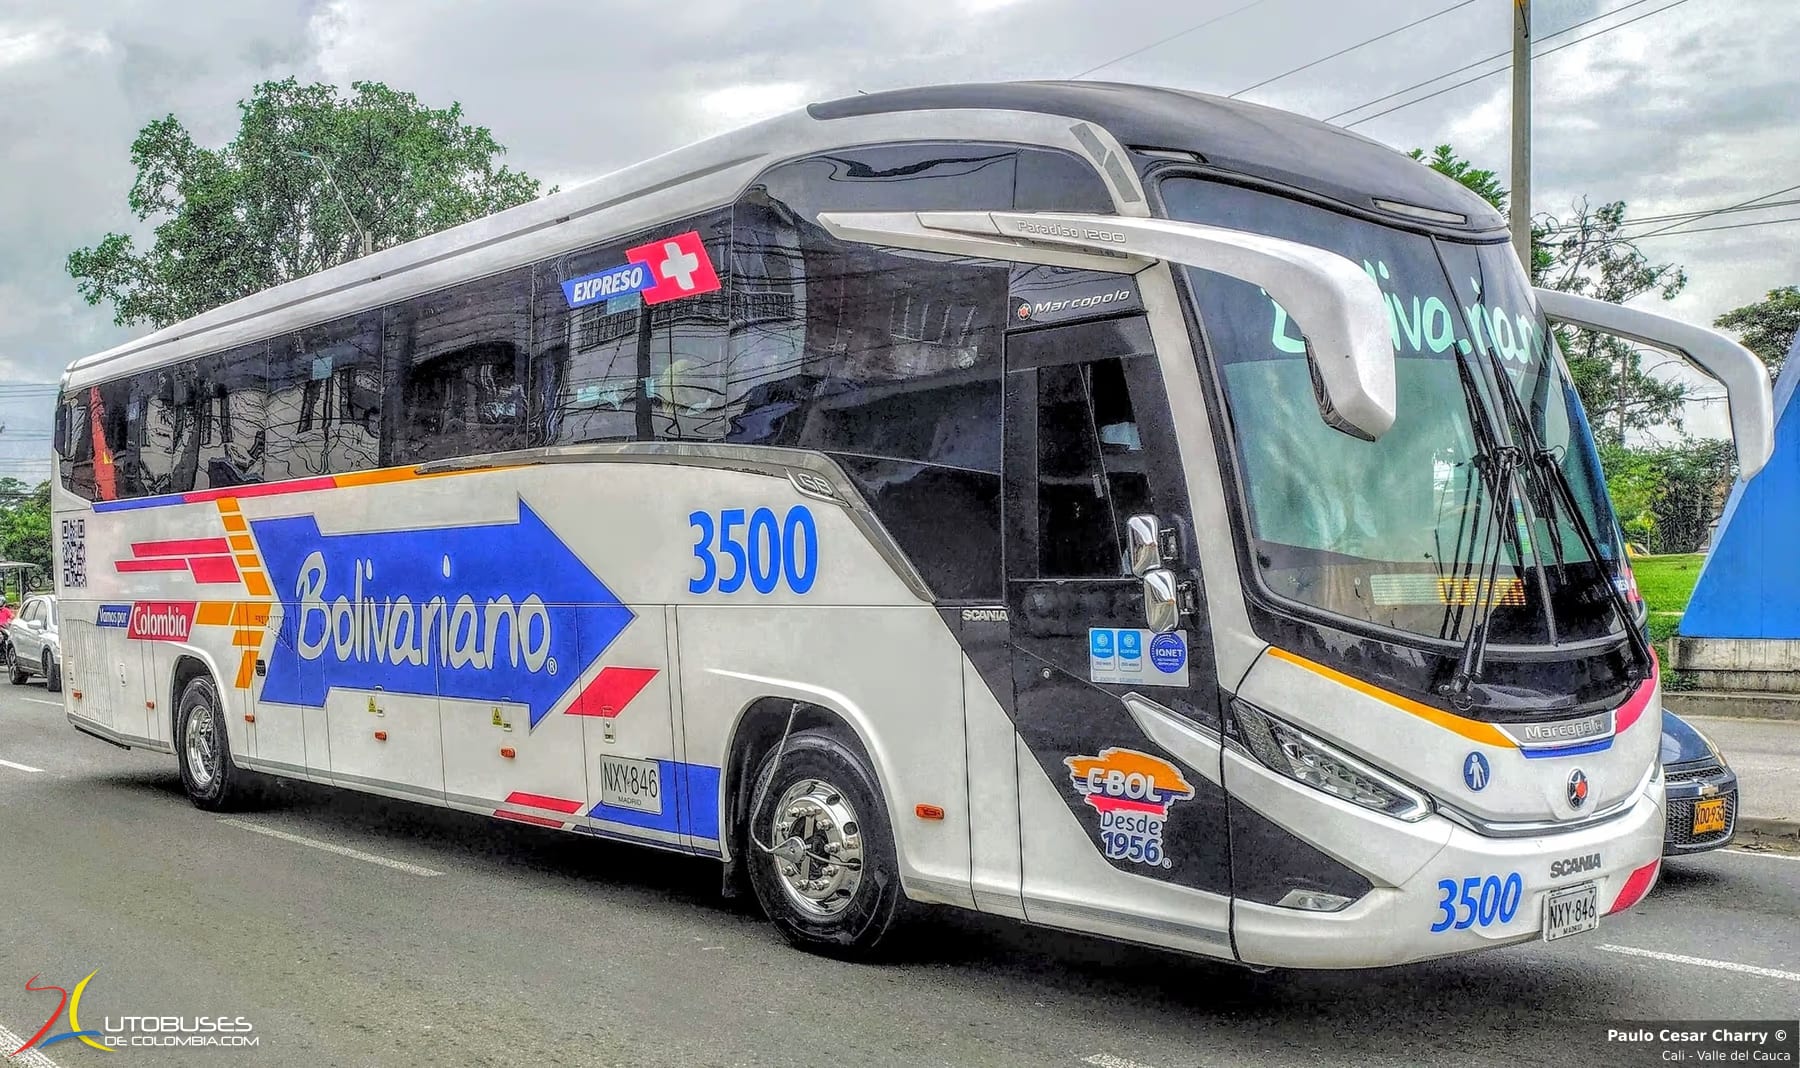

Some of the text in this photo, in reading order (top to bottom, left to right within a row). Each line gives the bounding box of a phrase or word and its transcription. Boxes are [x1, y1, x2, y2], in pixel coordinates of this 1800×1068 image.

[1017, 220, 1127, 244] Paradiso 1200
[573, 266, 643, 302] EXPRESO
[1034, 289, 1130, 314] Marcopolo
[688, 504, 818, 595] 3500
[133, 605, 187, 637] Colombia
[961, 609, 1009, 622] SCANIA
[1155, 648, 1183, 657] IQNET
[1524, 719, 1603, 739] Marcopolo
[1102, 811, 1159, 835] Desde
[1550, 852, 1601, 879] SCANIA
[1430, 872, 1523, 933] 3500
